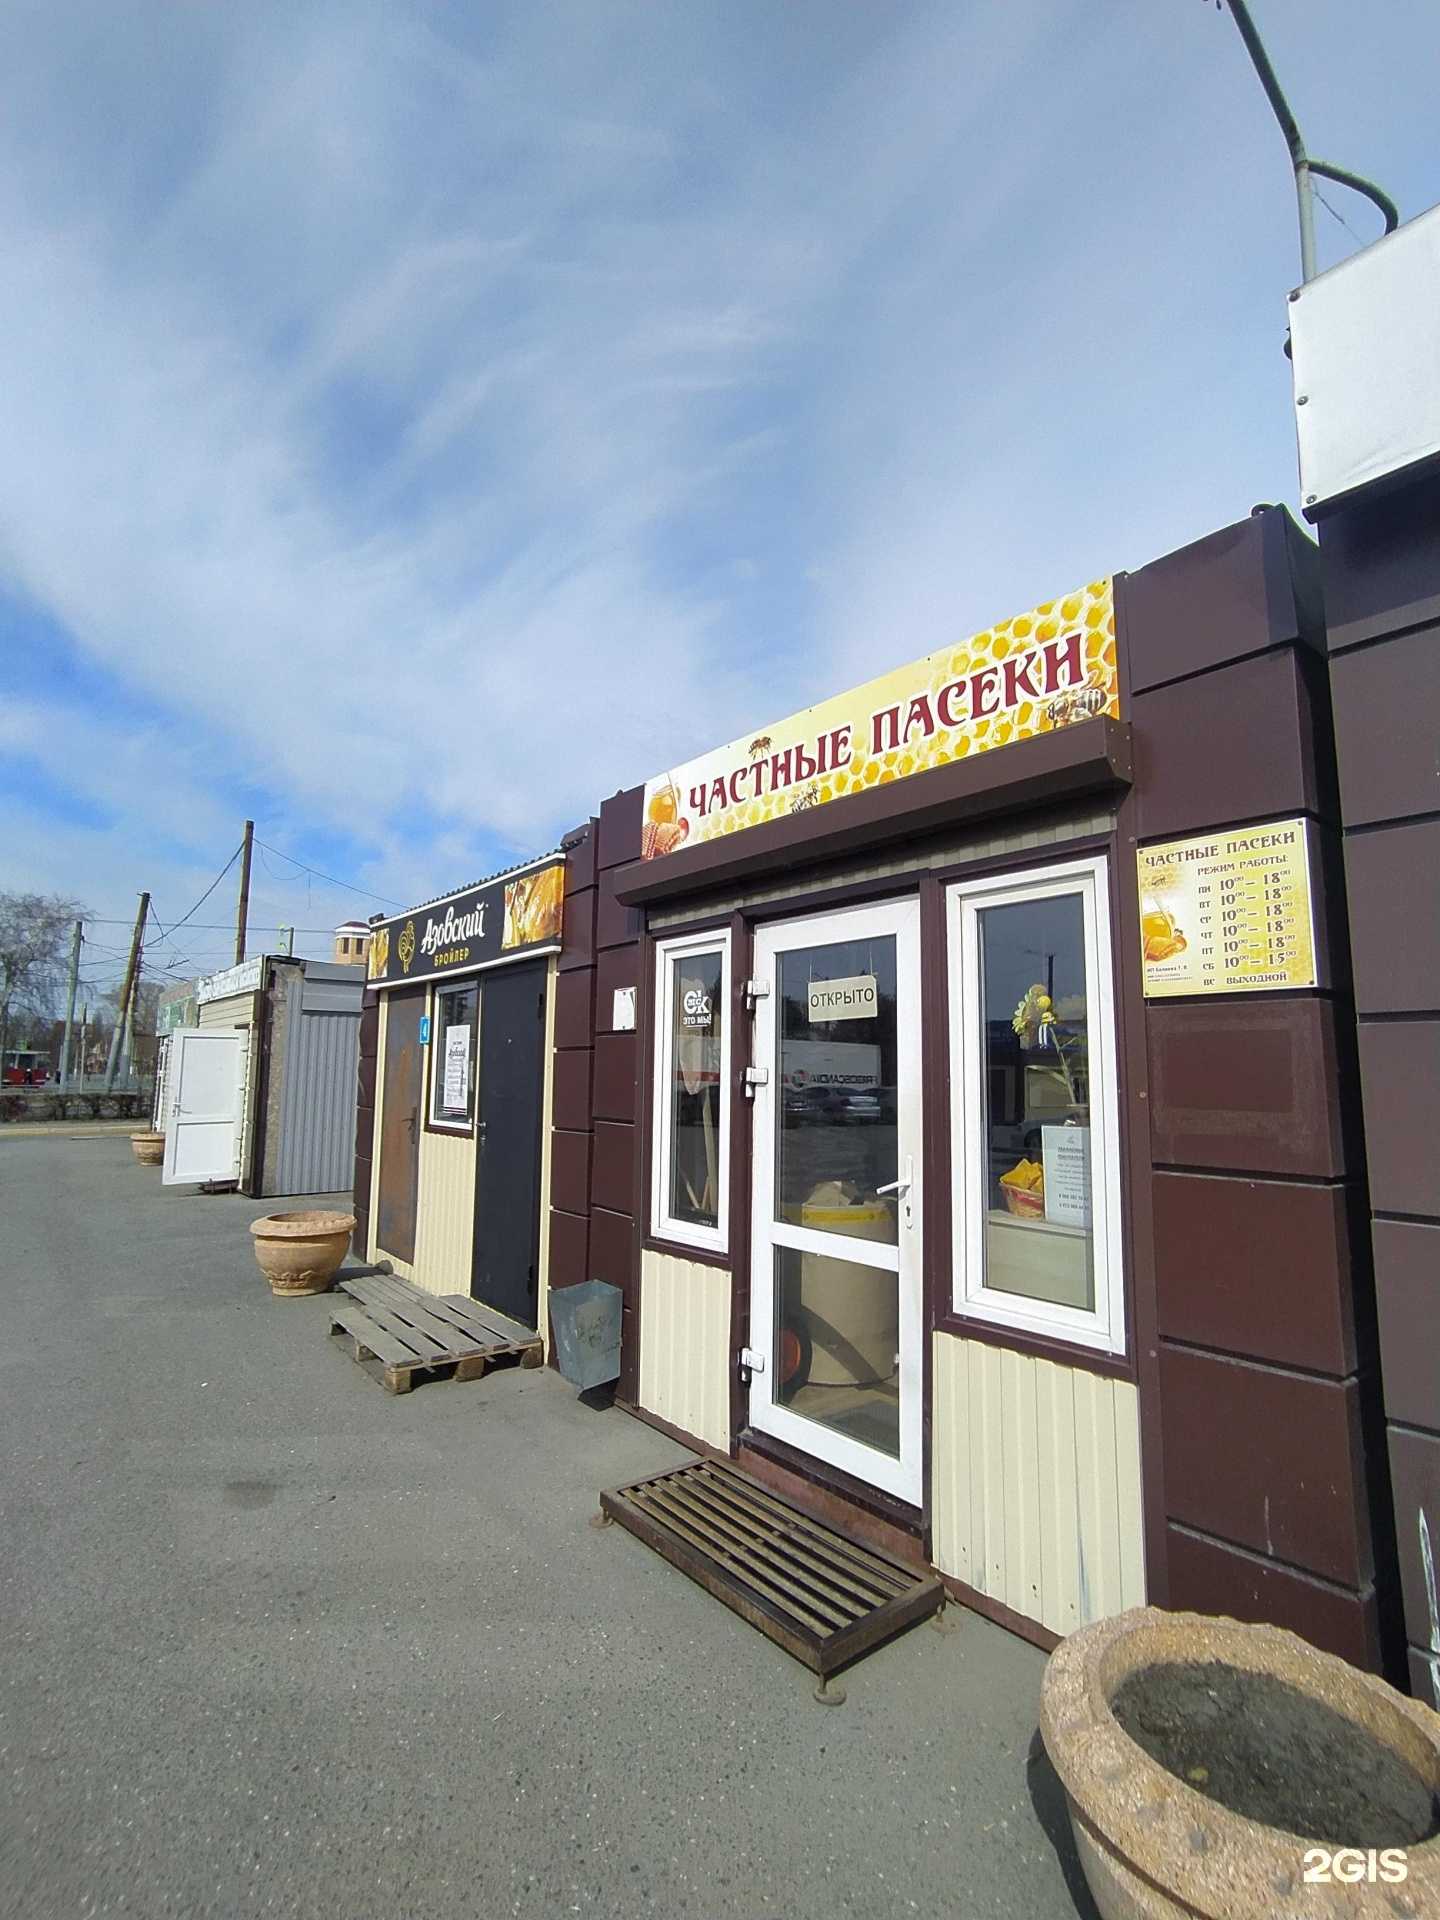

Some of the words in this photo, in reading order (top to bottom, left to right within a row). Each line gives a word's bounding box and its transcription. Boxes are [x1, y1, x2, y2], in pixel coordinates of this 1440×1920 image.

[689, 725, 852, 817] ЧАСТНЫЕ
[871, 633, 1086, 755] ПАСЕКИ
[1145, 845, 1219, 867] ЧАСТНЫЕ
[1227, 831, 1296, 854] ПАСЕКИ
[1197, 863, 1235, 876] РЕЖИМ
[1198, 885, 1211, 894] ПН
[1200, 900, 1211, 909] ВТ
[1200, 915, 1212, 924] СР
[420, 901, 486, 955] Азовский
[1201, 931, 1213, 939] ЧТ
[1202, 947, 1214, 955] ПТ
[434, 947, 470, 967] БРОЙЛЕР
[1203, 962, 1215, 970] СБ
[1203, 978, 1215, 986] ВС
[1226, 971, 1287, 985] ВЫХОДНОЙ
[810, 988, 875, 1008] ОТКРЫТО
[682, 1016, 696, 1025] ЭТО
